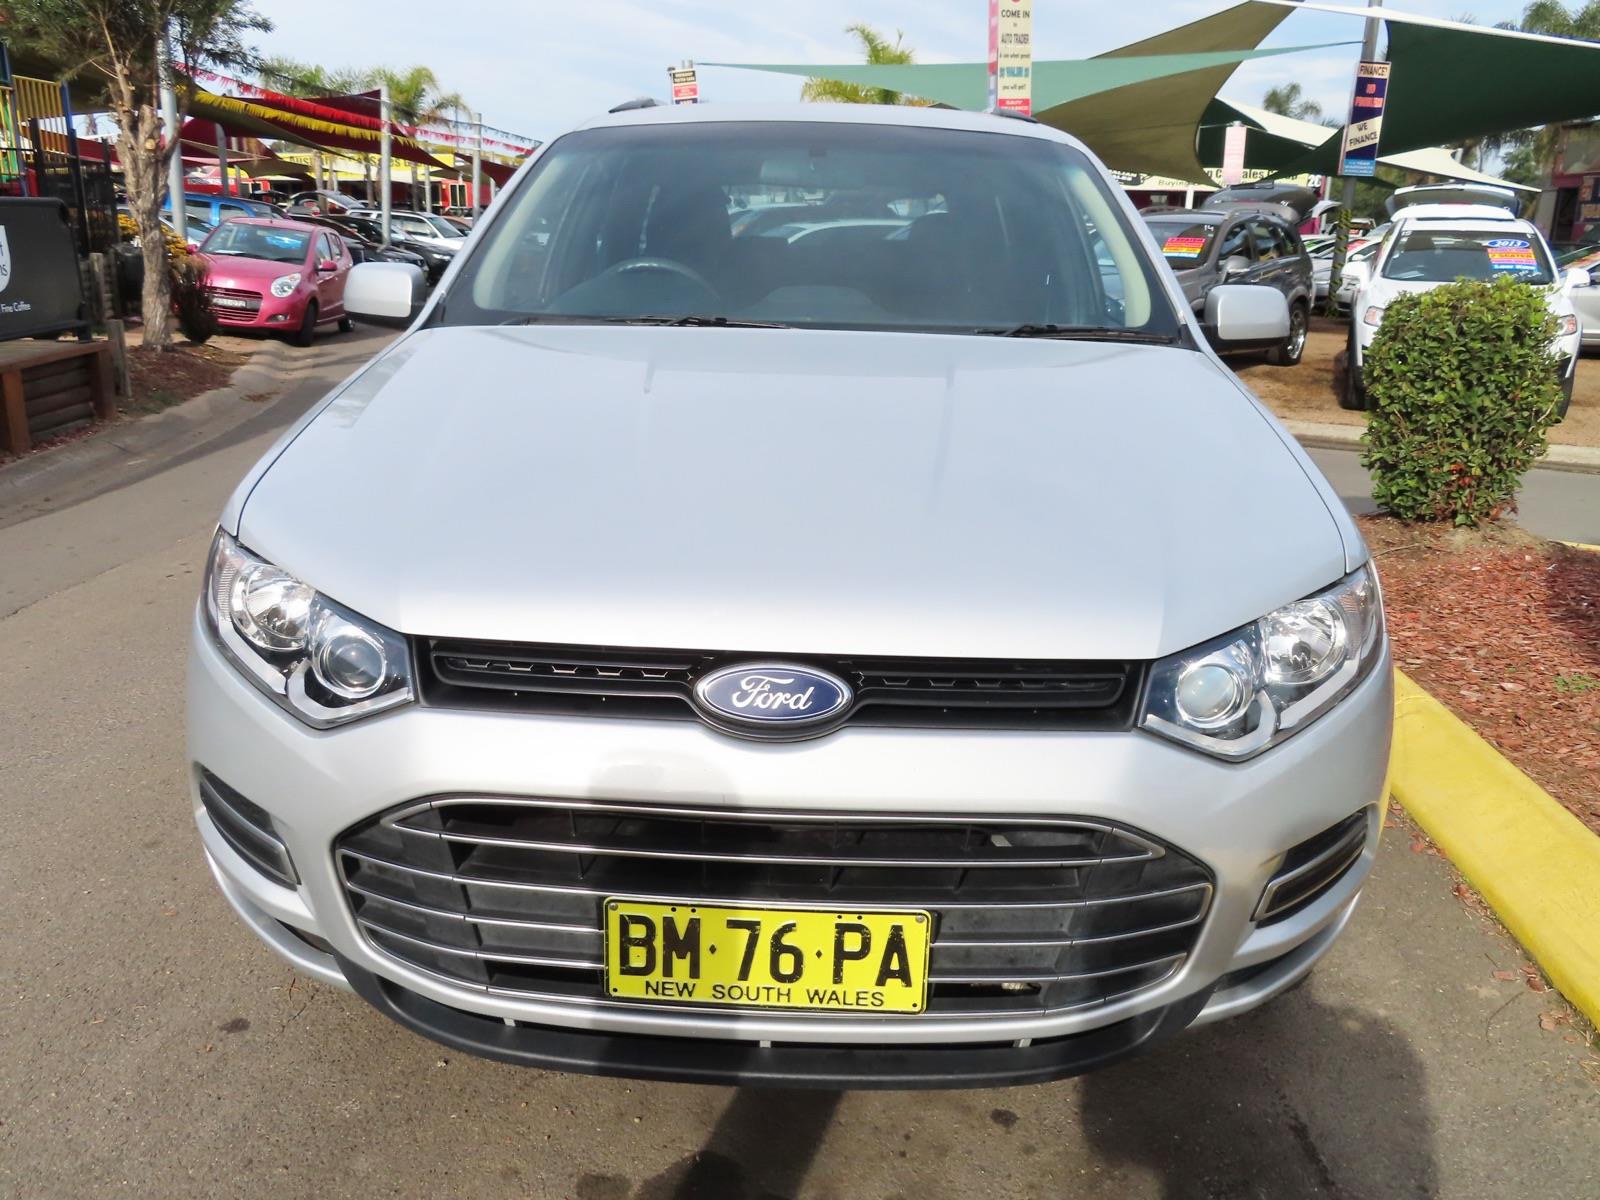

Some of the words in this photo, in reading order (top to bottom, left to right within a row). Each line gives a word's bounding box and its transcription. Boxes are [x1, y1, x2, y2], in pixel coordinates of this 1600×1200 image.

[1001, 9, 1020, 18] COME
[1022, 10, 1030, 18] IN
[1357, 122, 1368, 132] WE
[1349, 131, 1378, 147] FINANCE
[1495, 239, 1521, 248] 2013
[732, 675, 815, 710] Ford
[645, 980, 697, 998] NEW
[711, 984, 791, 1002] SOUTH
[806, 989, 884, 1006] WALES
